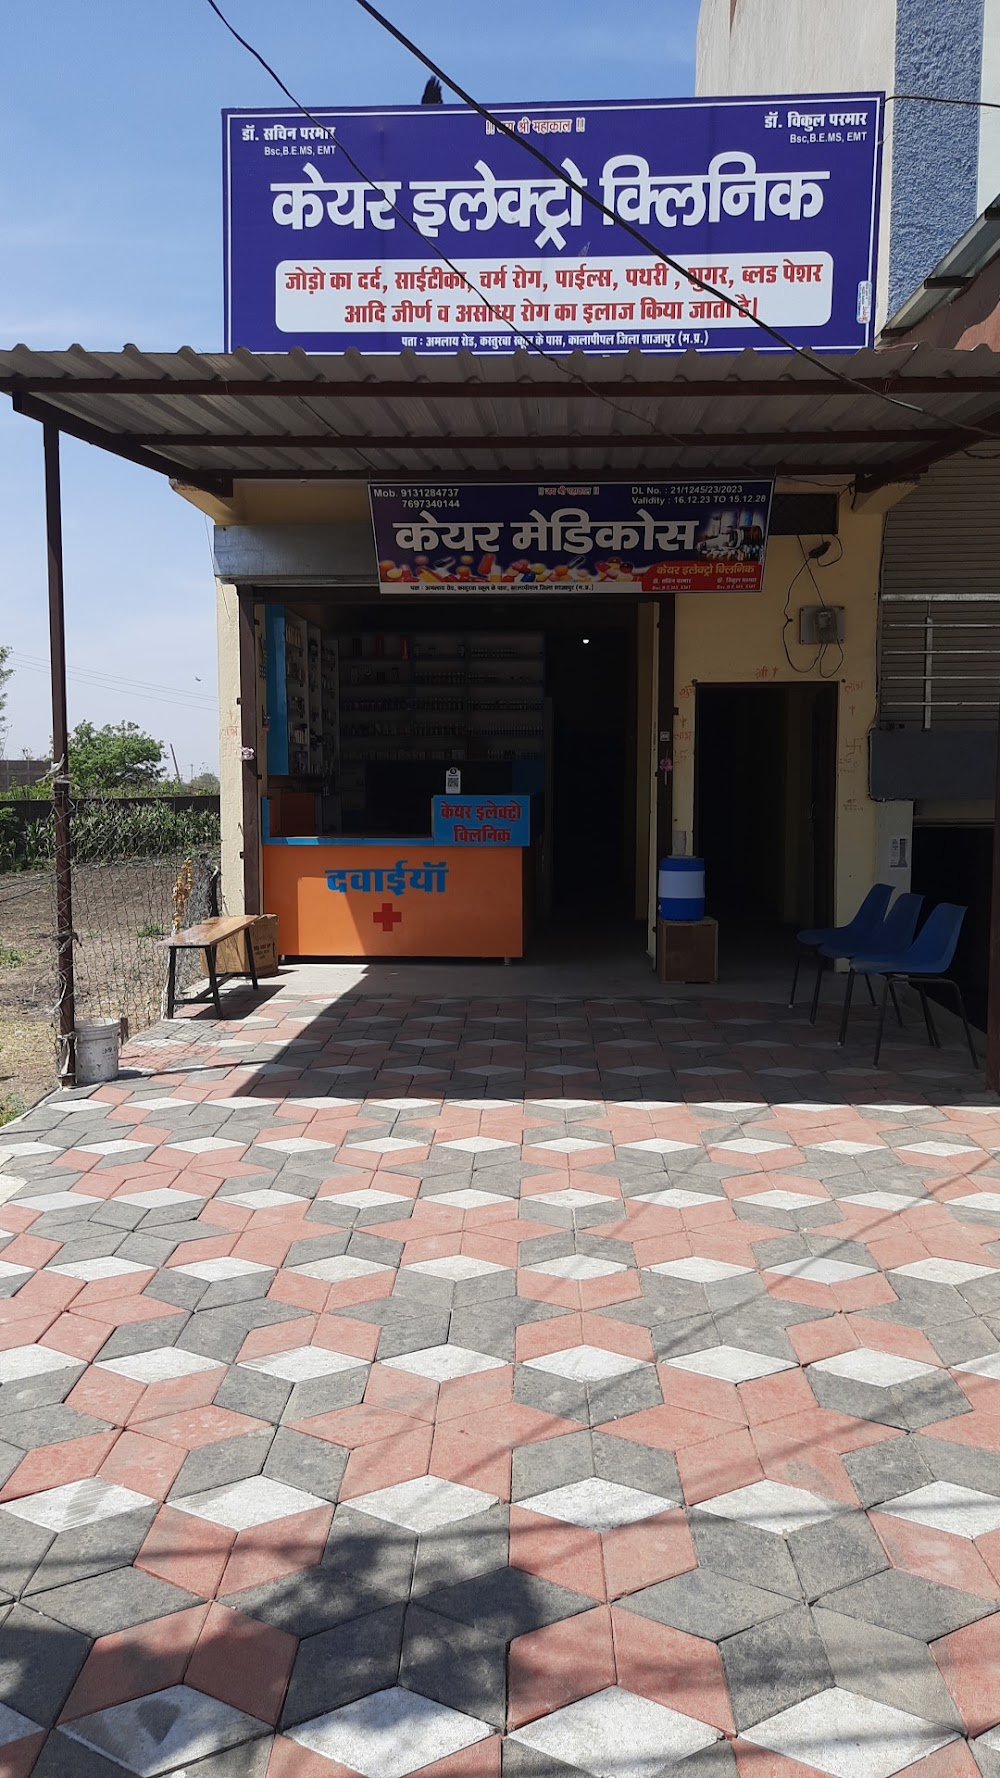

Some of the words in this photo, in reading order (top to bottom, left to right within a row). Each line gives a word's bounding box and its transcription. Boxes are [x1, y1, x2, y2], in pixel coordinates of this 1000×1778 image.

[518, 116, 531, 134] श्री
[532, 119, 572, 134] महाकाल
[764, 111, 782, 128] डॉ.
[787, 111, 826, 132] विकुल
[829, 112, 868, 126] परमार
[242, 124, 260, 141] डॉ.
[263, 124, 298, 141] सचिन
[300, 127, 336, 140] परमार
[790, 132, 844, 144] Bsc,B.E.MS,
[846, 132, 868, 142] EMT
[317, 145, 336, 155] EMT
[270, 162, 402, 230] केयर
[410, 157, 588, 251] इलेक्ट्रो
[599, 150, 831, 228] क्लिनिक
[284, 266, 326, 295] जोड़ो
[330, 272, 353, 290] का
[357, 265, 388, 294] दर्द,
[394, 265, 472, 293] साईटीका,
[480, 264, 508, 289] चर्म
[512, 264, 548, 292] रोग,
[554, 263, 619, 292] पाईल्स,
[626, 262, 670, 286] पथरी
[688, 266, 734, 292] शुगर,
[742, 265, 778, 284] ब्लड
[782, 258, 824, 284] पेशर
[344, 300, 387, 324] आदि
[391, 298, 432, 323] जीर्ण
[437, 304, 450, 323] व
[456, 303, 516, 324] असाध्य
[520, 298, 550, 322] रोग
[554, 303, 578, 321] का
[582, 302, 636, 324] इलाज
[640, 296, 684, 320] किया
[688, 300, 731, 320] जाता
[401, 336, 418, 347] पता
[426, 336, 460, 347] अमलाय
[461, 333, 478, 348] रोड,
[535, 332, 544, 346] के
[546, 335, 566, 348] पास,
[568, 332, 614, 346] कालापीपल
[616, 331, 640, 345] जिला
[641, 332, 676, 348] शाजापुर
[678, 330, 709, 346] (म.प्र.)
[374, 488, 398, 498] Mob.
[400, 488, 459, 497] 9131284737
[632, 486, 644, 494] DL
[647, 486, 661, 494] No.
[670, 484, 743, 494] 21/1245/23/2023
[402, 500, 460, 508] 7697340144
[632, 496, 666, 506] Validity
[674, 496, 710, 504] 16.12.23
[713, 495, 726, 503] TO
[730, 494, 766, 503] 15.12.28
[392, 510, 505, 552] केयर
[510, 507, 700, 554] मेडिकोस
[656, 564, 680, 575] केयर
[682, 564, 714, 576] इलेक्ट्रो
[716, 562, 755, 574] क्लिनिक
[441, 800, 472, 819] केयर
[476, 800, 522, 822] इलेक्ट्रो
[454, 824, 512, 842] क्लिनिक
